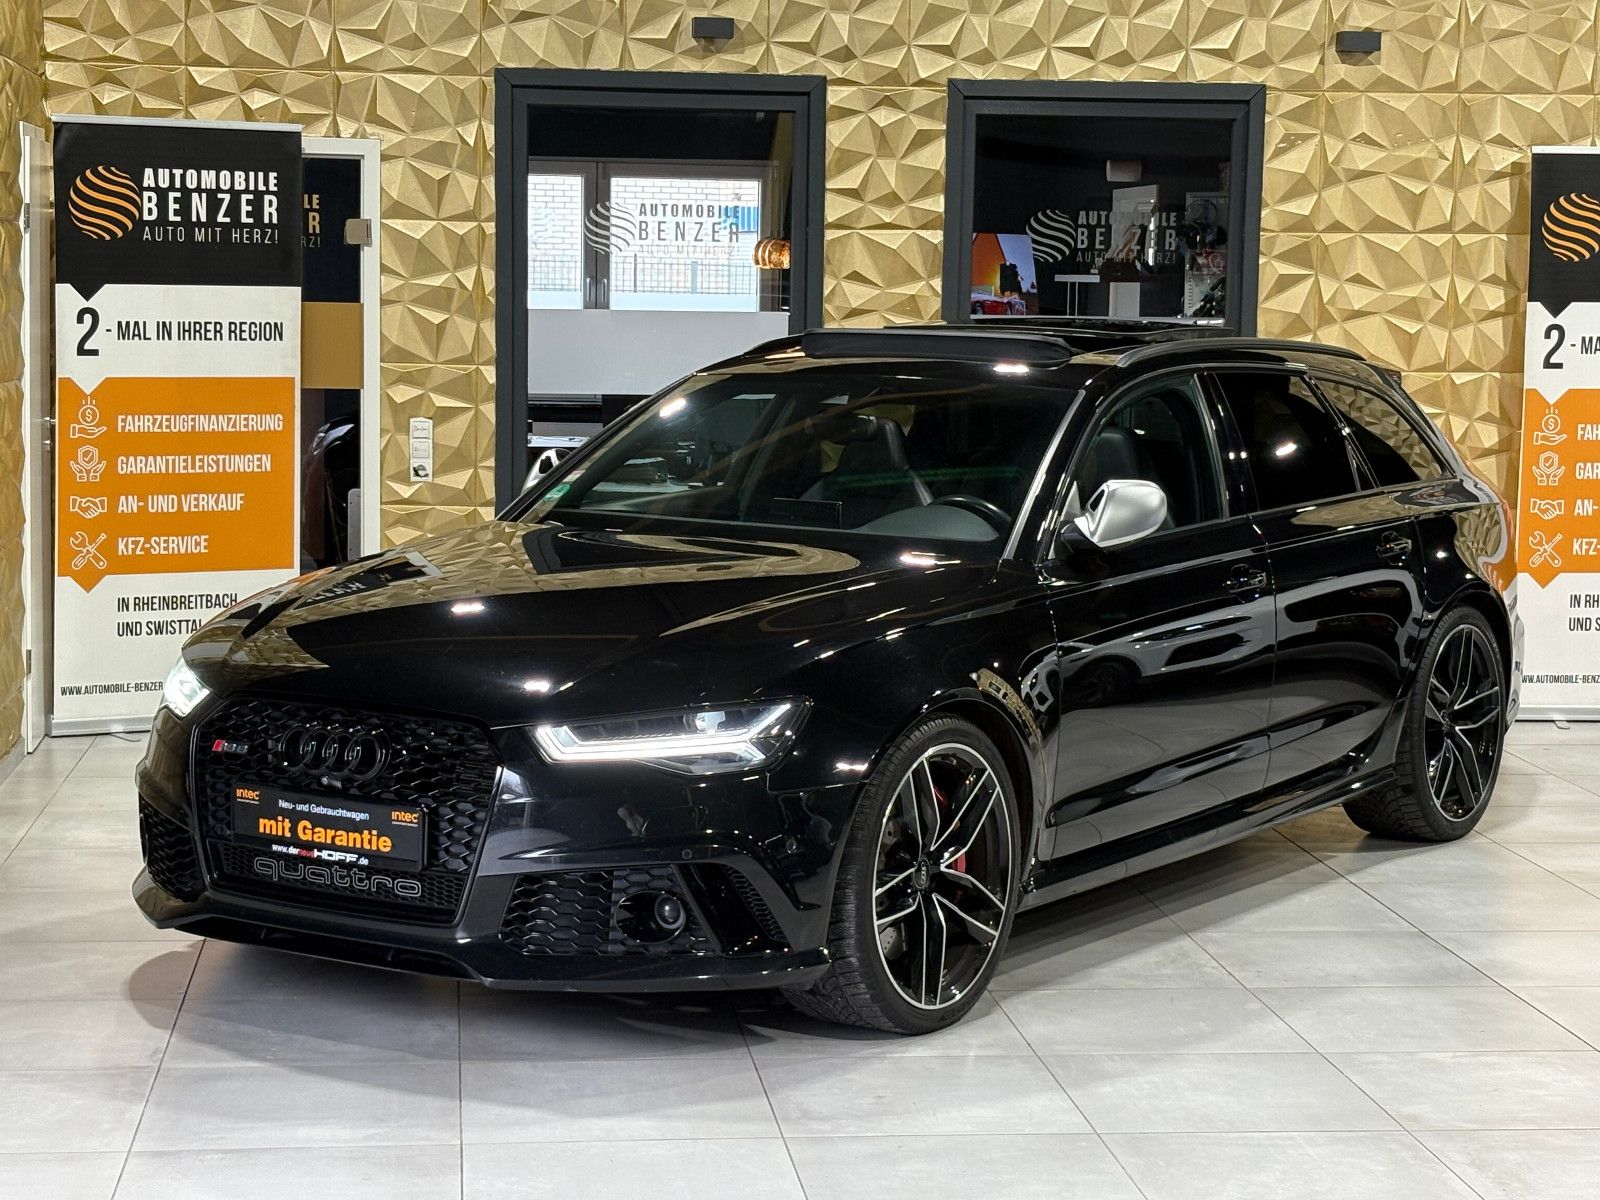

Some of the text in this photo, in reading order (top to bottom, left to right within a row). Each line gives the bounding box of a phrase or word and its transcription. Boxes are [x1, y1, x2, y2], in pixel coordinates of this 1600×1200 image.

[143, 168, 278, 191] AUTOMOBILE
[143, 191, 278, 224] BENZER
[639, 203, 739, 219] AUTOMOBILE
[143, 226, 278, 244] AUTO MIT HERZ!
[639, 221, 739, 243] BENZER
[1077, 227, 1176, 251] BEZER
[1140, 252, 1176, 264] HRZ!
[76, 307, 100, 357] 2
[117, 321, 153, 341] MAL
[156, 321, 173, 341] IN
[177, 321, 223, 342] IHRER
[228, 322, 284, 342] REGION
[1542, 324, 1566, 369] 2
[117, 413, 283, 433] FAHRZEUGFINANZIERUNG
[117, 454, 271, 475] GARANTIELEISTUNGEN
[118, 493, 245, 514] AN- UND VERKAUF
[1573, 499, 1599, 516] AN-
[118, 535, 209, 556] KFZ-SERVICE
[117, 593, 238, 612] IN RHEINBREITBACH
[1569, 594, 1600, 608] IN RH
[117, 621, 142, 637] UND
[1569, 617, 1592, 631] UND
[60, 681, 164, 696] WWW.AUTOMOBILE-BENZER
[279, 799, 370, 821] Neu- und Gebrauchtwagen
[259, 816, 393, 853] mit Garantie
[254, 856, 422, 897] quattro
